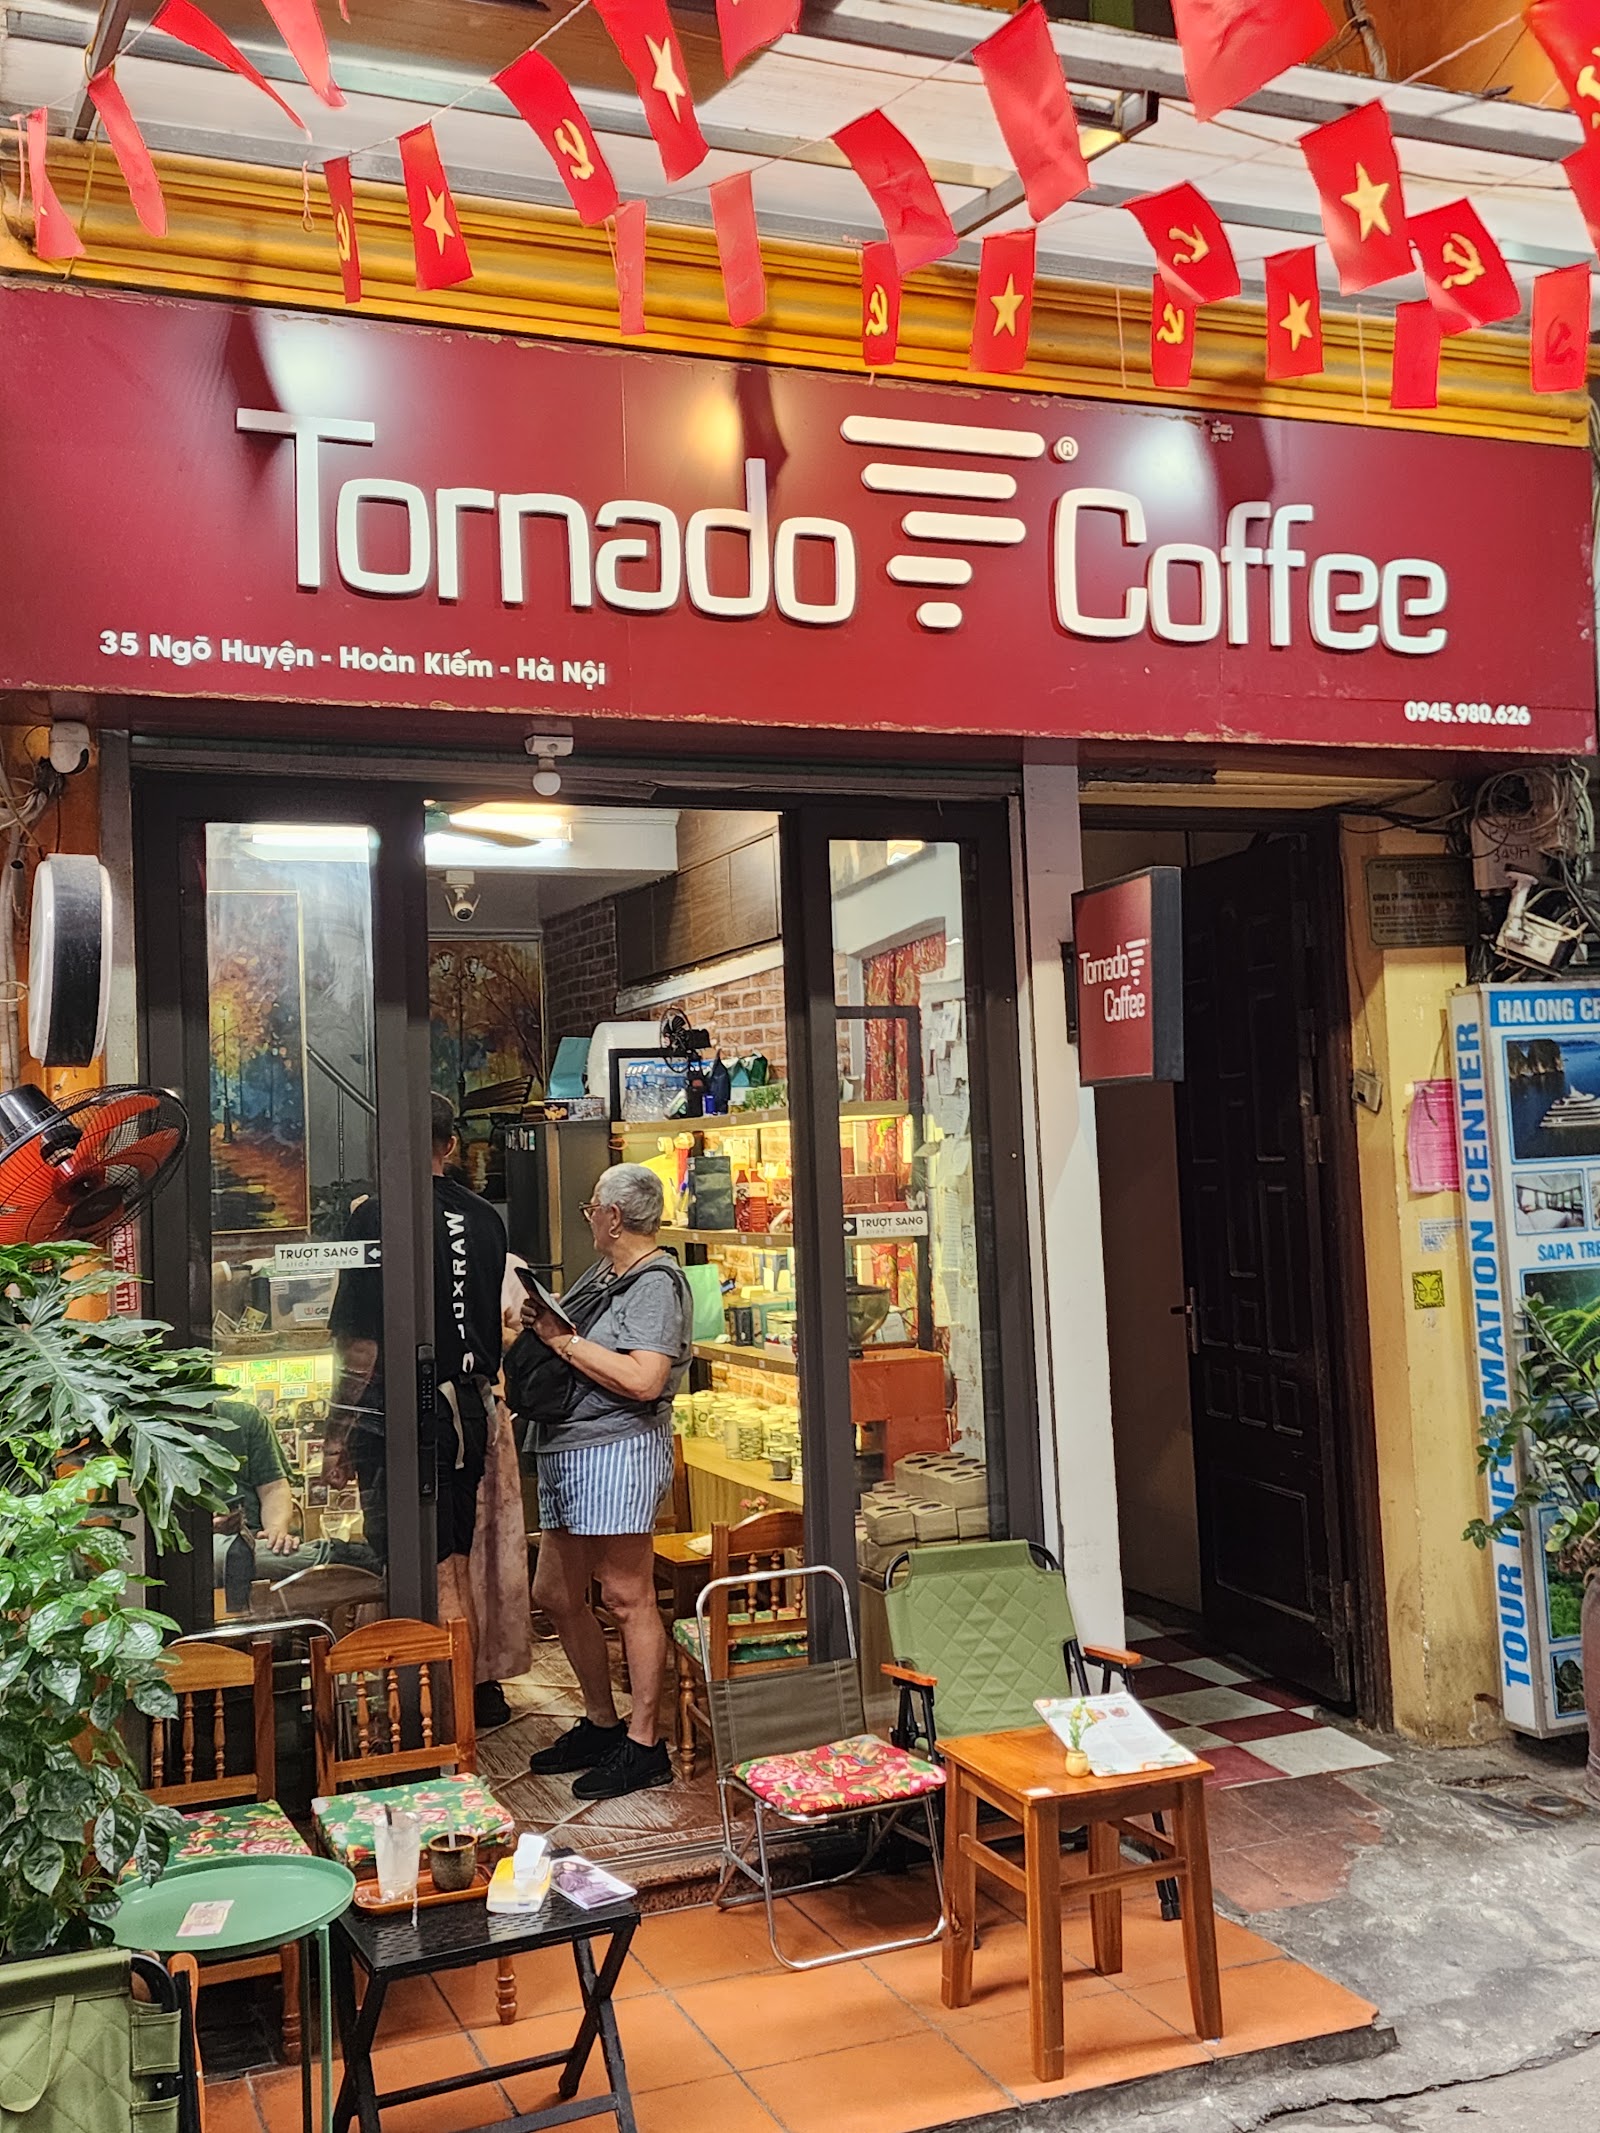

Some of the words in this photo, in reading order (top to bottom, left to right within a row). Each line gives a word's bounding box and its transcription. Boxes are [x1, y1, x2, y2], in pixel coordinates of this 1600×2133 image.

[236, 408, 856, 624] Tornado
[1054, 487, 1448, 655] Coffee
[100, 630, 139, 656] 35
[150, 634, 212, 666] Ngõ
[221, 640, 314, 672] Huyện
[339, 646, 416, 673] Hoàn
[423, 649, 493, 678] Kiếm
[516, 656, 555, 682] Hà
[562, 660, 606, 691] Nội
[1404, 700, 1531, 726] 0945.980.626
[1079, 945, 1129, 985] Tornado
[1103, 985, 1145, 1022] Coffee
[1498, 998, 1575, 1023] HALONG
[1455, 1022, 1492, 1202] CENTER
[896, 1216, 923, 1226] SANG
[279, 1246, 319, 1261] TRƯỢT
[323, 1246, 358, 1257] SANG
[1537, 1243, 1575, 1261] SAPA
[1495, 1563, 1531, 1687] TOUR
